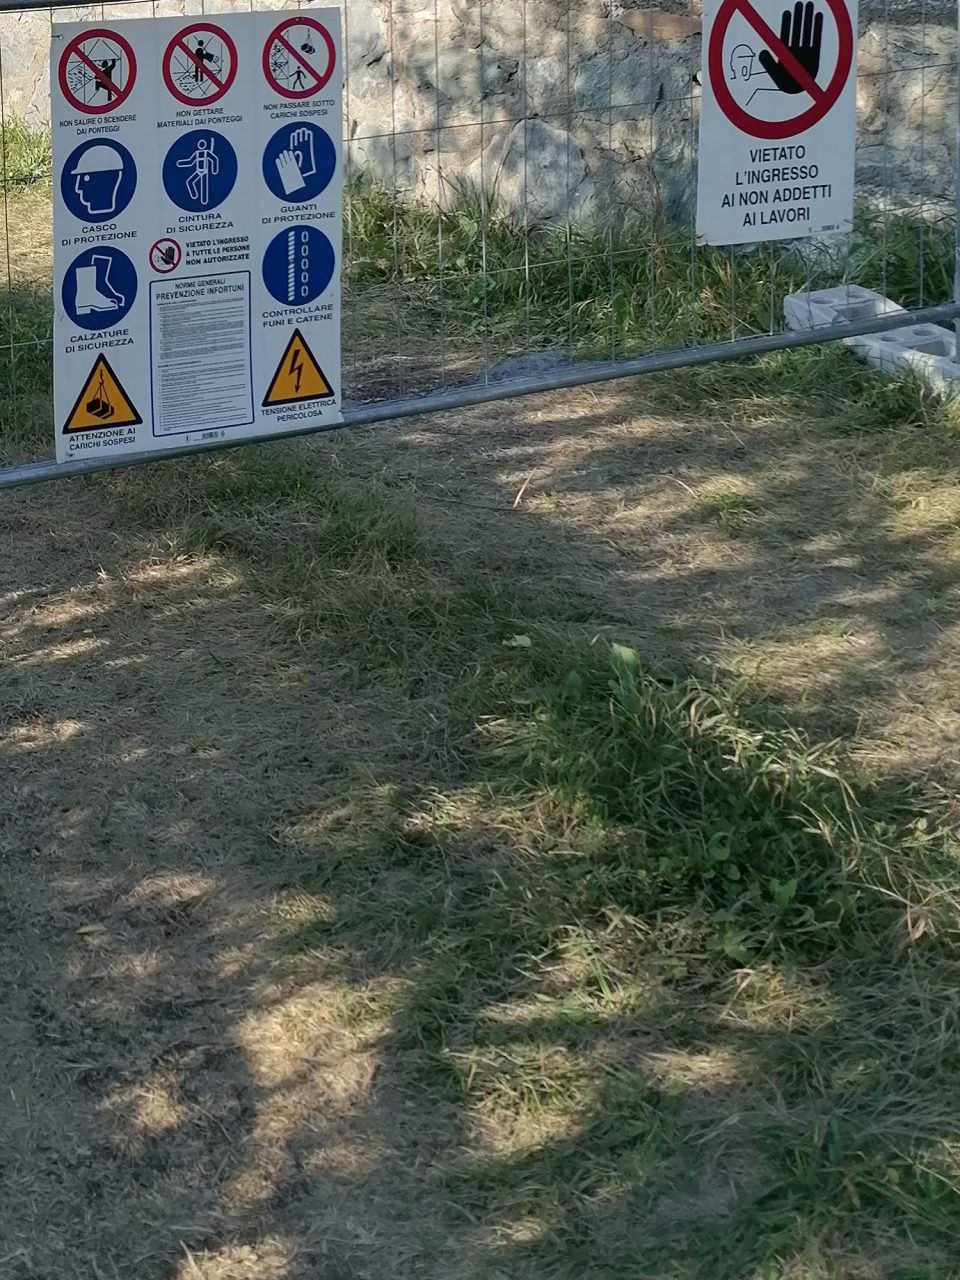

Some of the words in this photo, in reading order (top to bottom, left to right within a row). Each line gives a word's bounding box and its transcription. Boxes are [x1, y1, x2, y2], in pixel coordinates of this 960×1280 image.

[192, 107, 224, 116] GETTARE
[280, 101, 310, 109] PASSARE
[74, 118, 96, 126] SALIRE
[104, 114, 137, 123] SCENDERE
[270, 111, 297, 119] CARICHI
[299, 109, 328, 117] SOSPESI
[157, 120, 193, 128] MATERIALI
[195, 118, 206, 126] DAI
[207, 115, 243, 125] PONTEGGI
[88, 125, 120, 134] PONTEGGI
[749, 145, 806, 163] VIETATO
[735, 164, 819, 186] L'INGRESSO
[721, 193, 735, 208] AI
[739, 190, 769, 206] NON
[772, 184, 832, 203] ADDETTI
[280, 204, 317, 213] GUANTI
[178, 213, 222, 223] CINTURA
[274, 211, 336, 223] PROTEZIONE
[742, 212, 756, 227] AI
[760, 206, 810, 225] LAVORI
[82, 223, 117, 234] CASCO
[178, 221, 234, 233] SICUREZZA
[61, 238, 71, 246] DI
[74, 231, 138, 244] PROTEZIONE
[186, 240, 211, 248] VIETATO
[213, 236, 249, 245] L'INGRESSO
[222, 245, 250, 253] PERSONE
[203, 253, 250, 264] AUTORIZZATE
[175, 281, 196, 289] NORME
[197, 278, 226, 287] GENERALI
[156, 289, 205, 300] PREVENZIONE
[207, 284, 244, 295] INFORTUNI
[262, 303, 333, 318] CONTROLLARE
[262, 319, 285, 328] FUNI
[296, 313, 333, 323] CATENE
[70, 328, 129, 343] CALZATURE
[77, 338, 134, 352] SICUREZZA
[261, 405, 297, 416] TENSIONE
[298, 399, 336, 410] ELETTRICA
[276, 409, 323, 422] PERICOLOSA
[69, 429, 124, 442] ATTENZIONE
[126, 427, 136, 435] AI
[69, 441, 101, 451] CARICHI
[102, 436, 136, 447] SOSPESI
